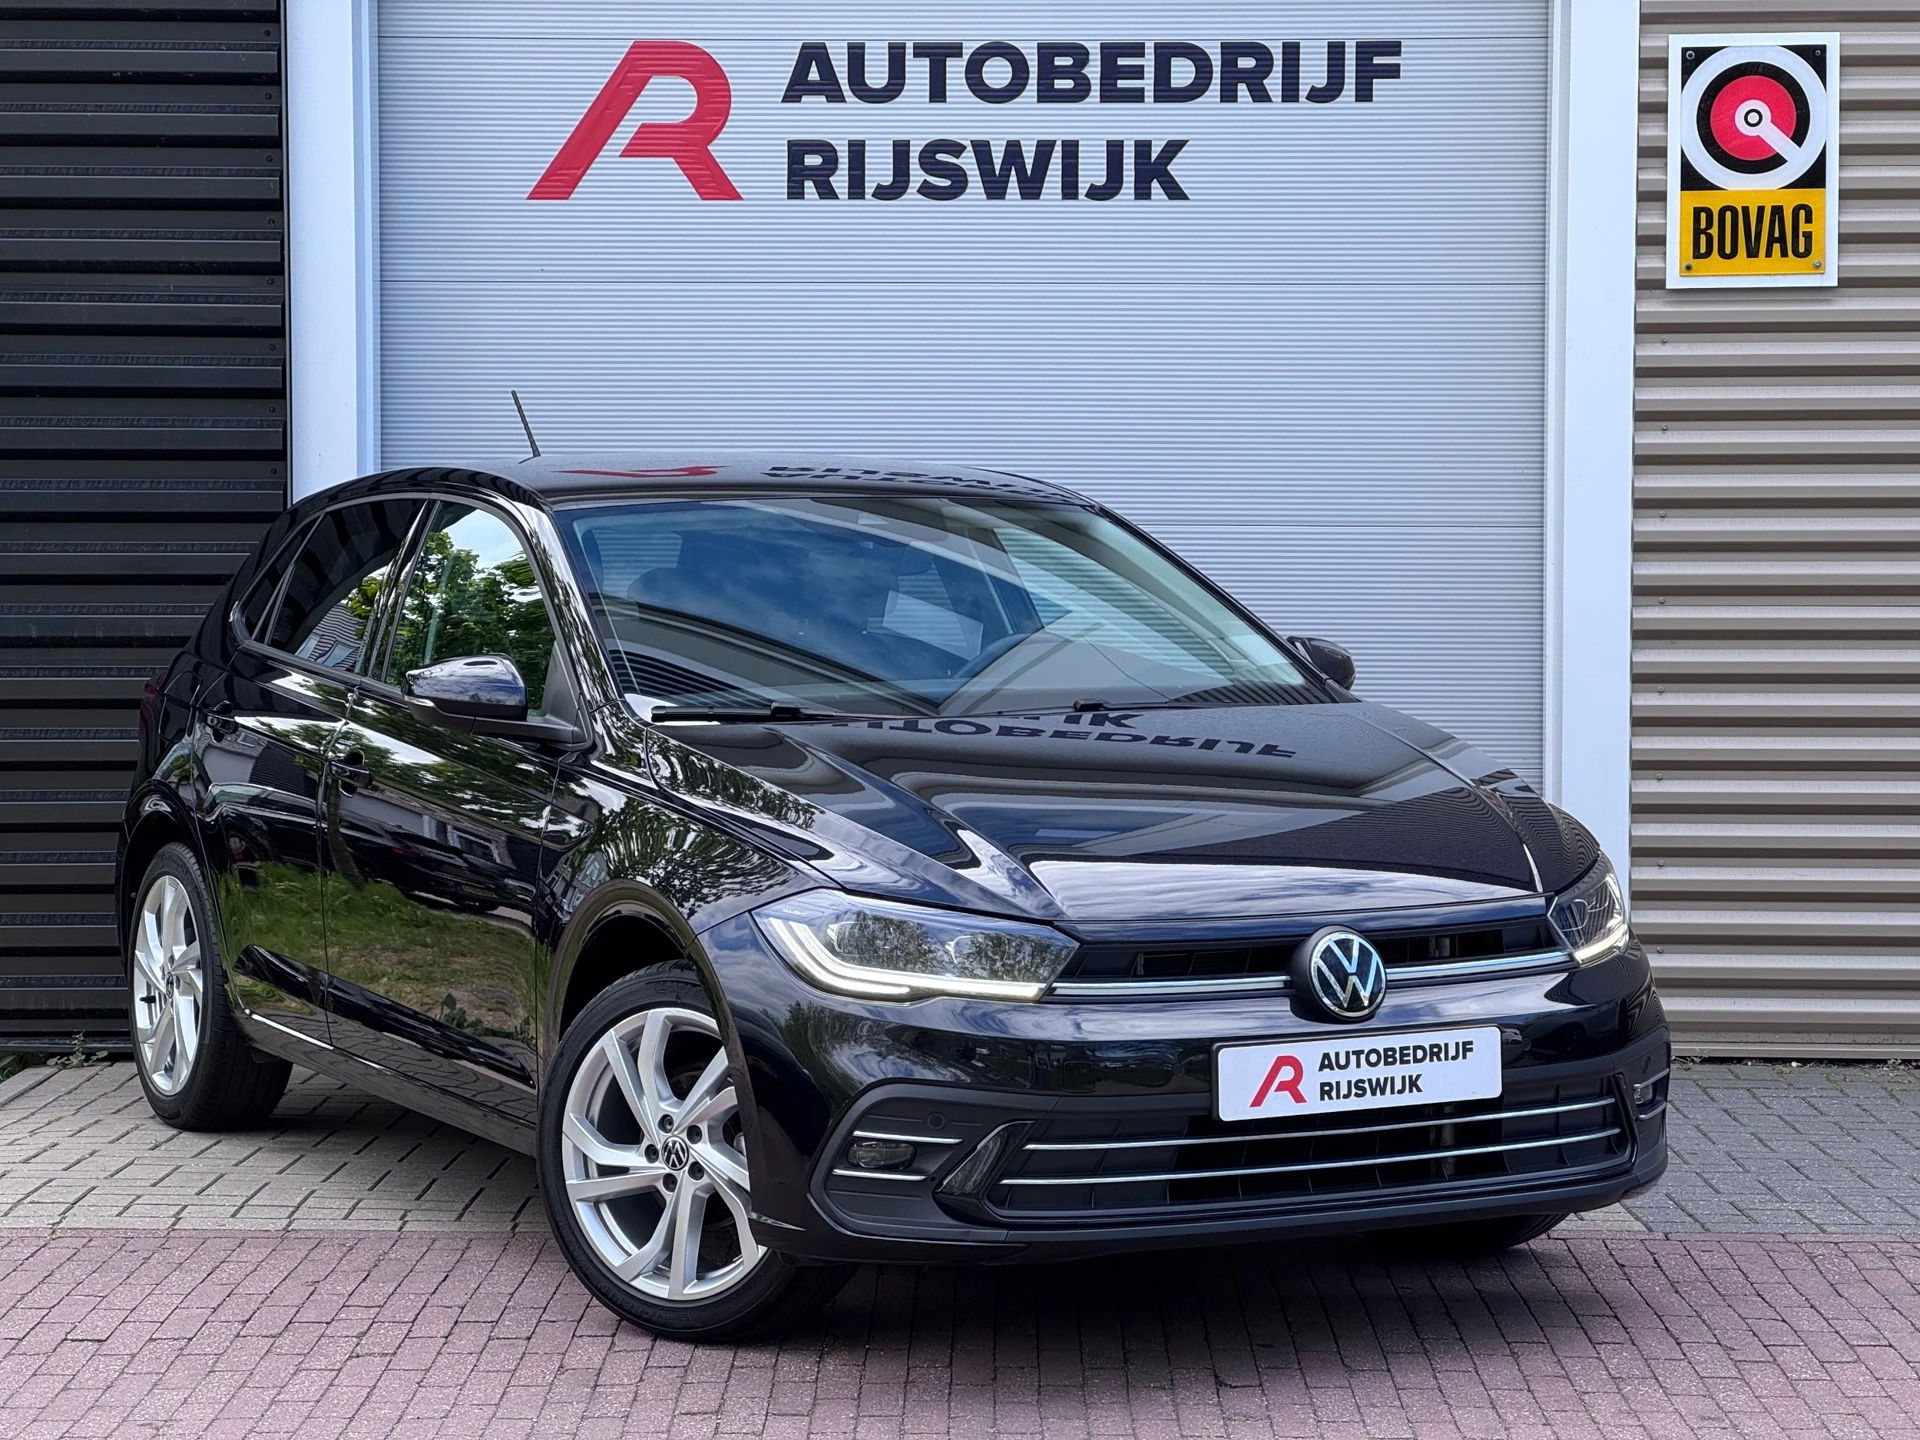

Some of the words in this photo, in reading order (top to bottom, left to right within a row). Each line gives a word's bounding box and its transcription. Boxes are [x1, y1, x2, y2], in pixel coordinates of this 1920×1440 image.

[781, 41, 1402, 104] AUTOBEDRIJF
[787, 138, 1191, 201] RIJSWIJK
[1692, 203, 1813, 260] BOVAG
[1318, 1040, 1474, 1072] AUTOBEDRIJF
[1319, 1074, 1423, 1102] RIJSWIJK
